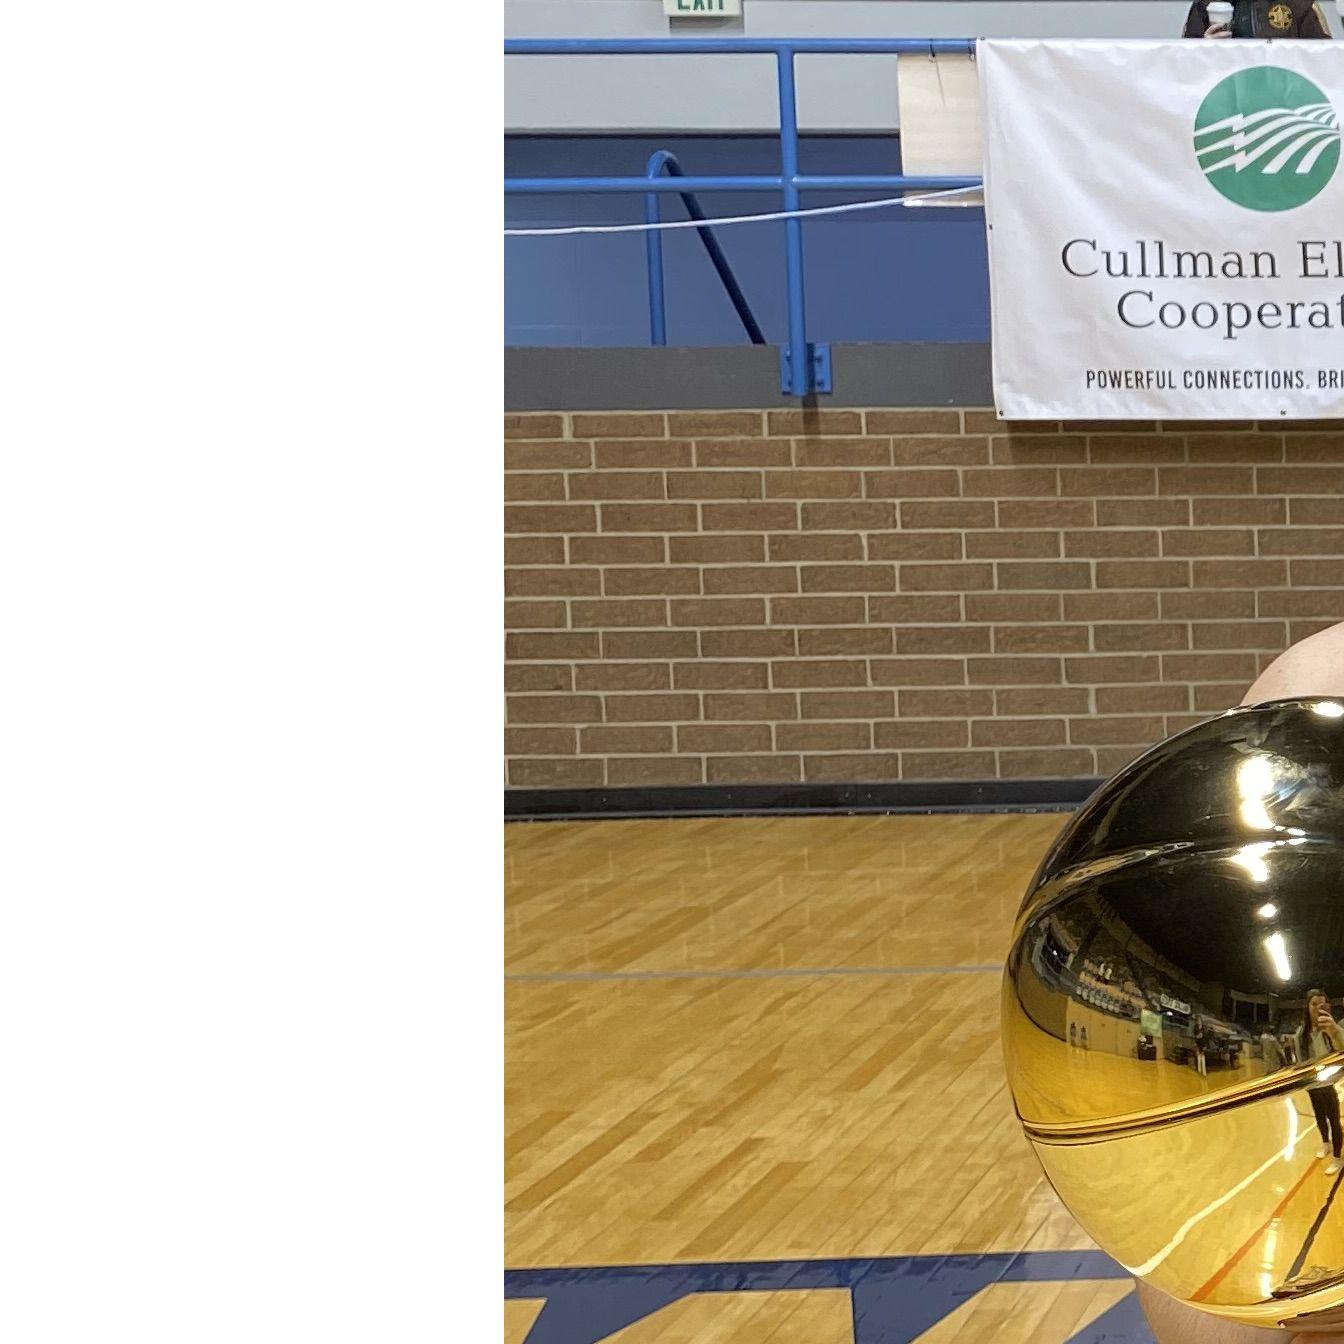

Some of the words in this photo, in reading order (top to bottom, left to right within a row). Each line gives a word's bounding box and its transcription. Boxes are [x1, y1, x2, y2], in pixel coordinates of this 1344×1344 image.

[1061, 238, 1281, 279] Cullman
[1086, 369, 1177, 390] POWERFUL
[1183, 369, 1311, 390] CONNECTIONS.
